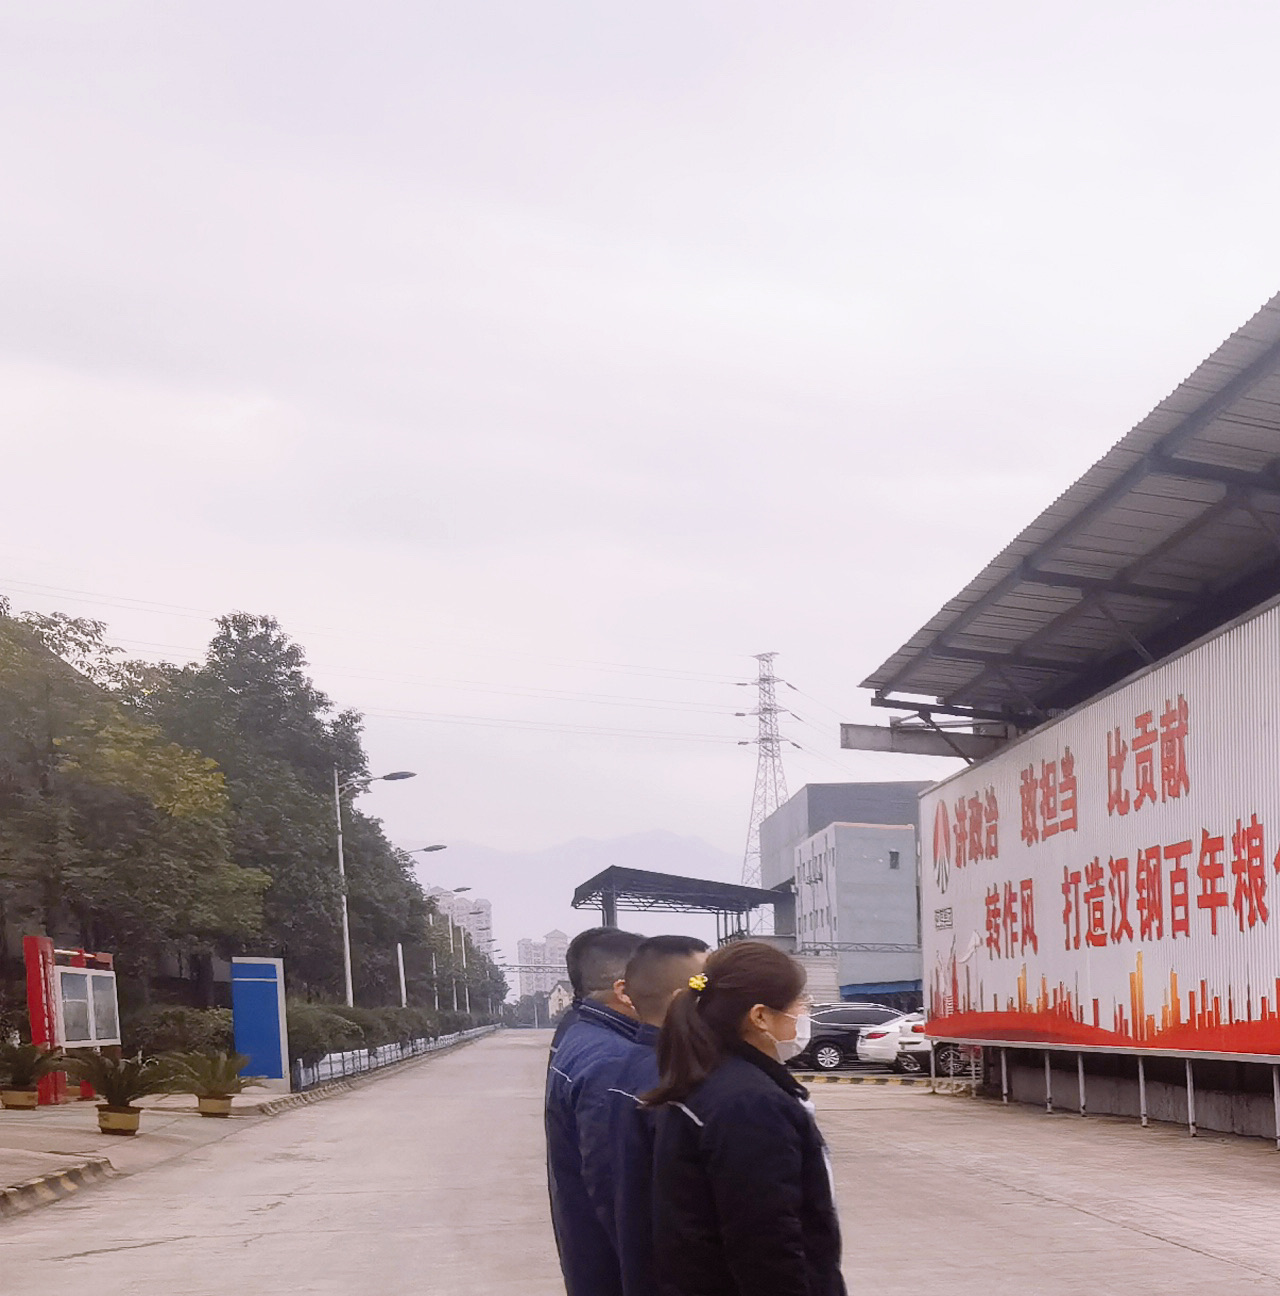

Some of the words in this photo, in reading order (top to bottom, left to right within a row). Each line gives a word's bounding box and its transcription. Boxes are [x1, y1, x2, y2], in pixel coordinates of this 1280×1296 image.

[953, 784, 999, 869] 讲政治
[1019, 746, 1078, 848] 敢担当
[1107, 694, 1190, 817] 比贡献
[985, 878, 1038, 960] 转作风
